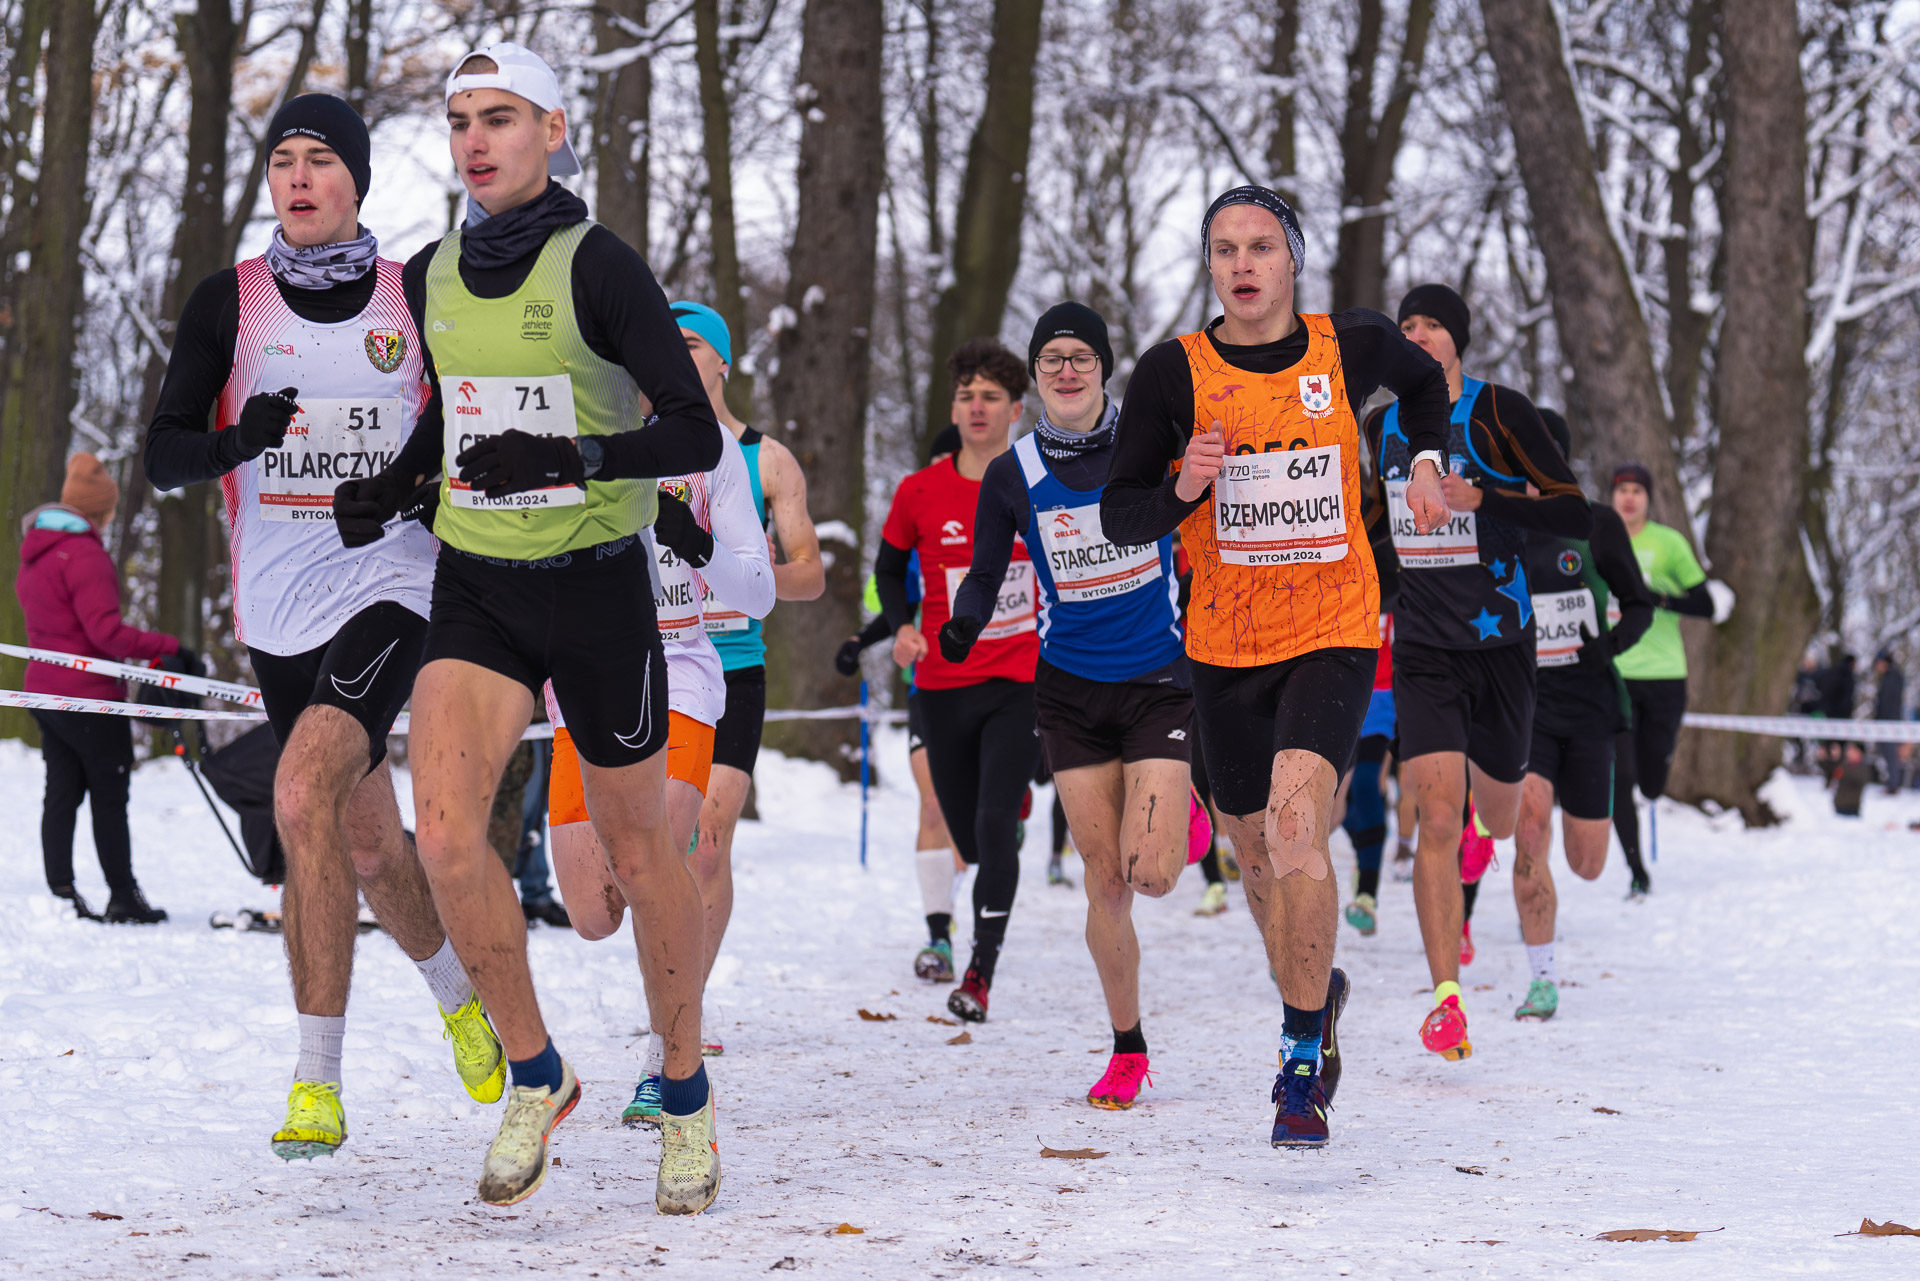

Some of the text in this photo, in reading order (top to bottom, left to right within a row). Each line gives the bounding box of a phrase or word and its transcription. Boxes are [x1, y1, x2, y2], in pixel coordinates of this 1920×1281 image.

[523, 304, 553, 319] PRO
[521, 320, 552, 330] athlete
[263, 344, 295, 356] esa
[515, 386, 550, 411] 71
[456, 405, 481, 415] ORLEN
[348, 407, 381, 430] 51
[1228, 465, 1250, 477] 770
[1287, 453, 1330, 481] 647
[472, 494, 548, 506] BYTOM 2024
[291, 510, 336, 520] BYTOM
[1220, 494, 1340, 527] RZEMPOŁUCH
[1054, 528, 1082, 539] ORLEN
[1248, 551, 1322, 563] BYTOM 2024
[1004, 565, 1026, 582] 27
[1081, 578, 1141, 599] BYTOM 2024
[1557, 595, 1587, 612] 388
[703, 622, 725, 630] 2024
[660, 631, 680, 641] 024
